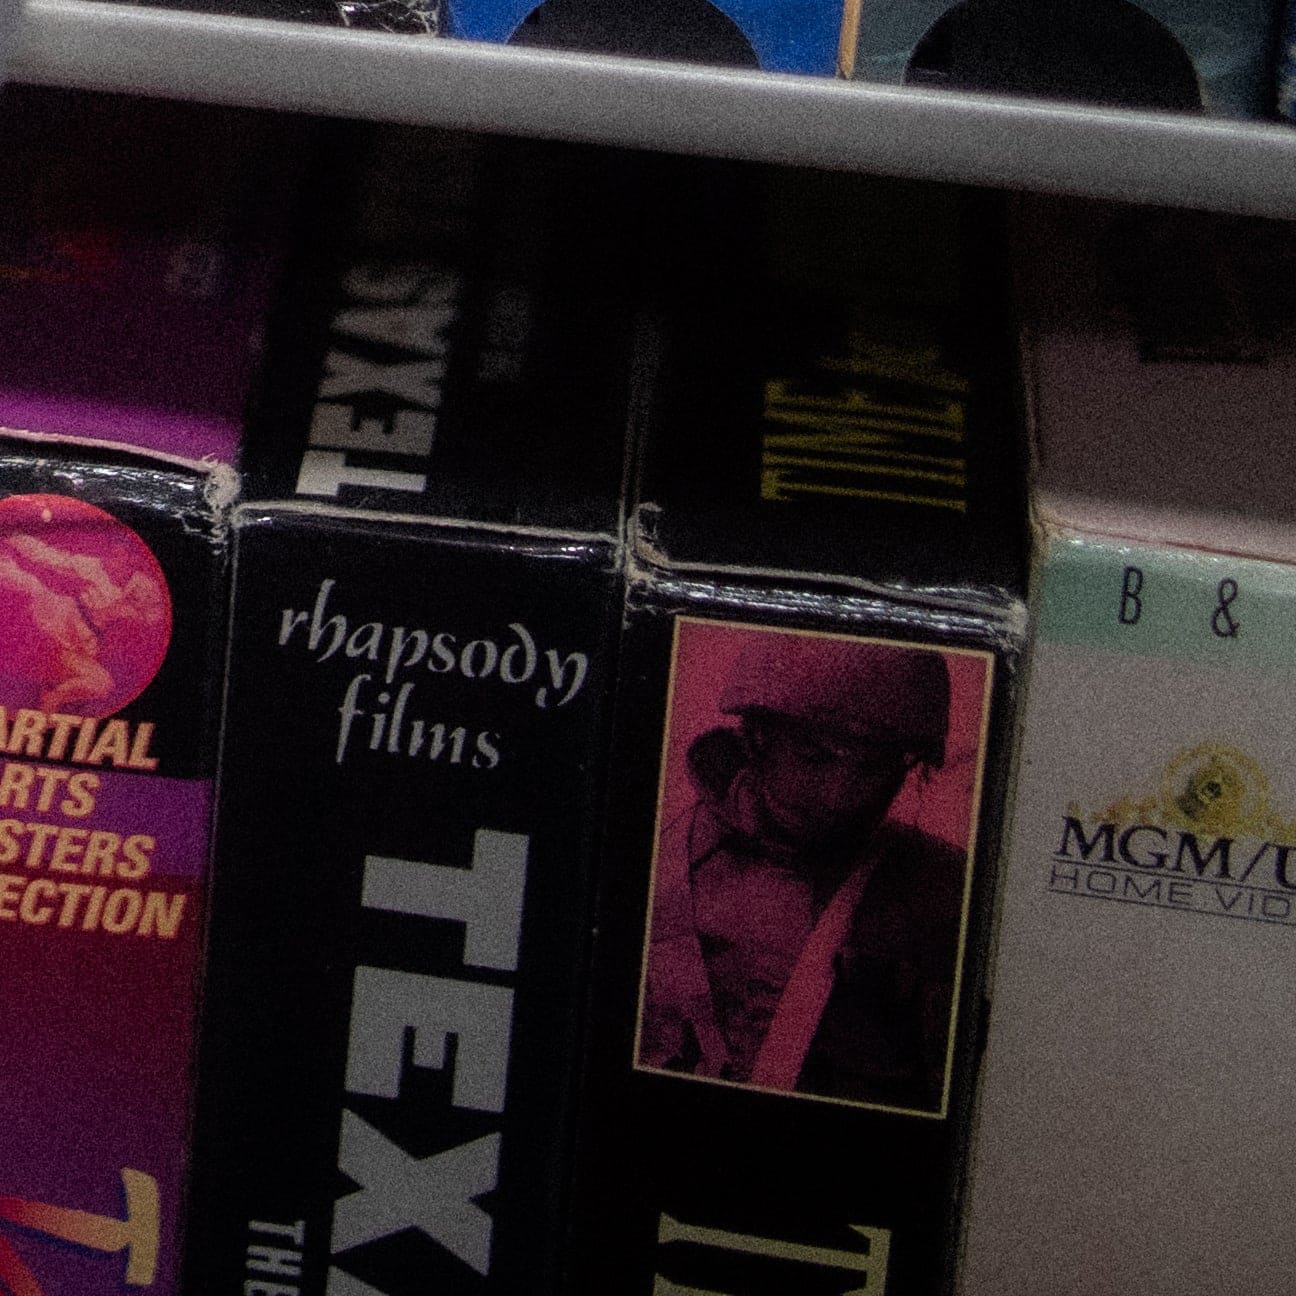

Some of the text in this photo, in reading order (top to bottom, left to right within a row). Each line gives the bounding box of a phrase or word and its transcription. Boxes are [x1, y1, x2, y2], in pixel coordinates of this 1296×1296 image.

[276, 577, 590, 708] rhapsody
[1119, 566, 1242, 639] B &
[336, 672, 503, 768] films
[1049, 864, 1194, 906] HOME
[325, 826, 531, 1296] TEX
